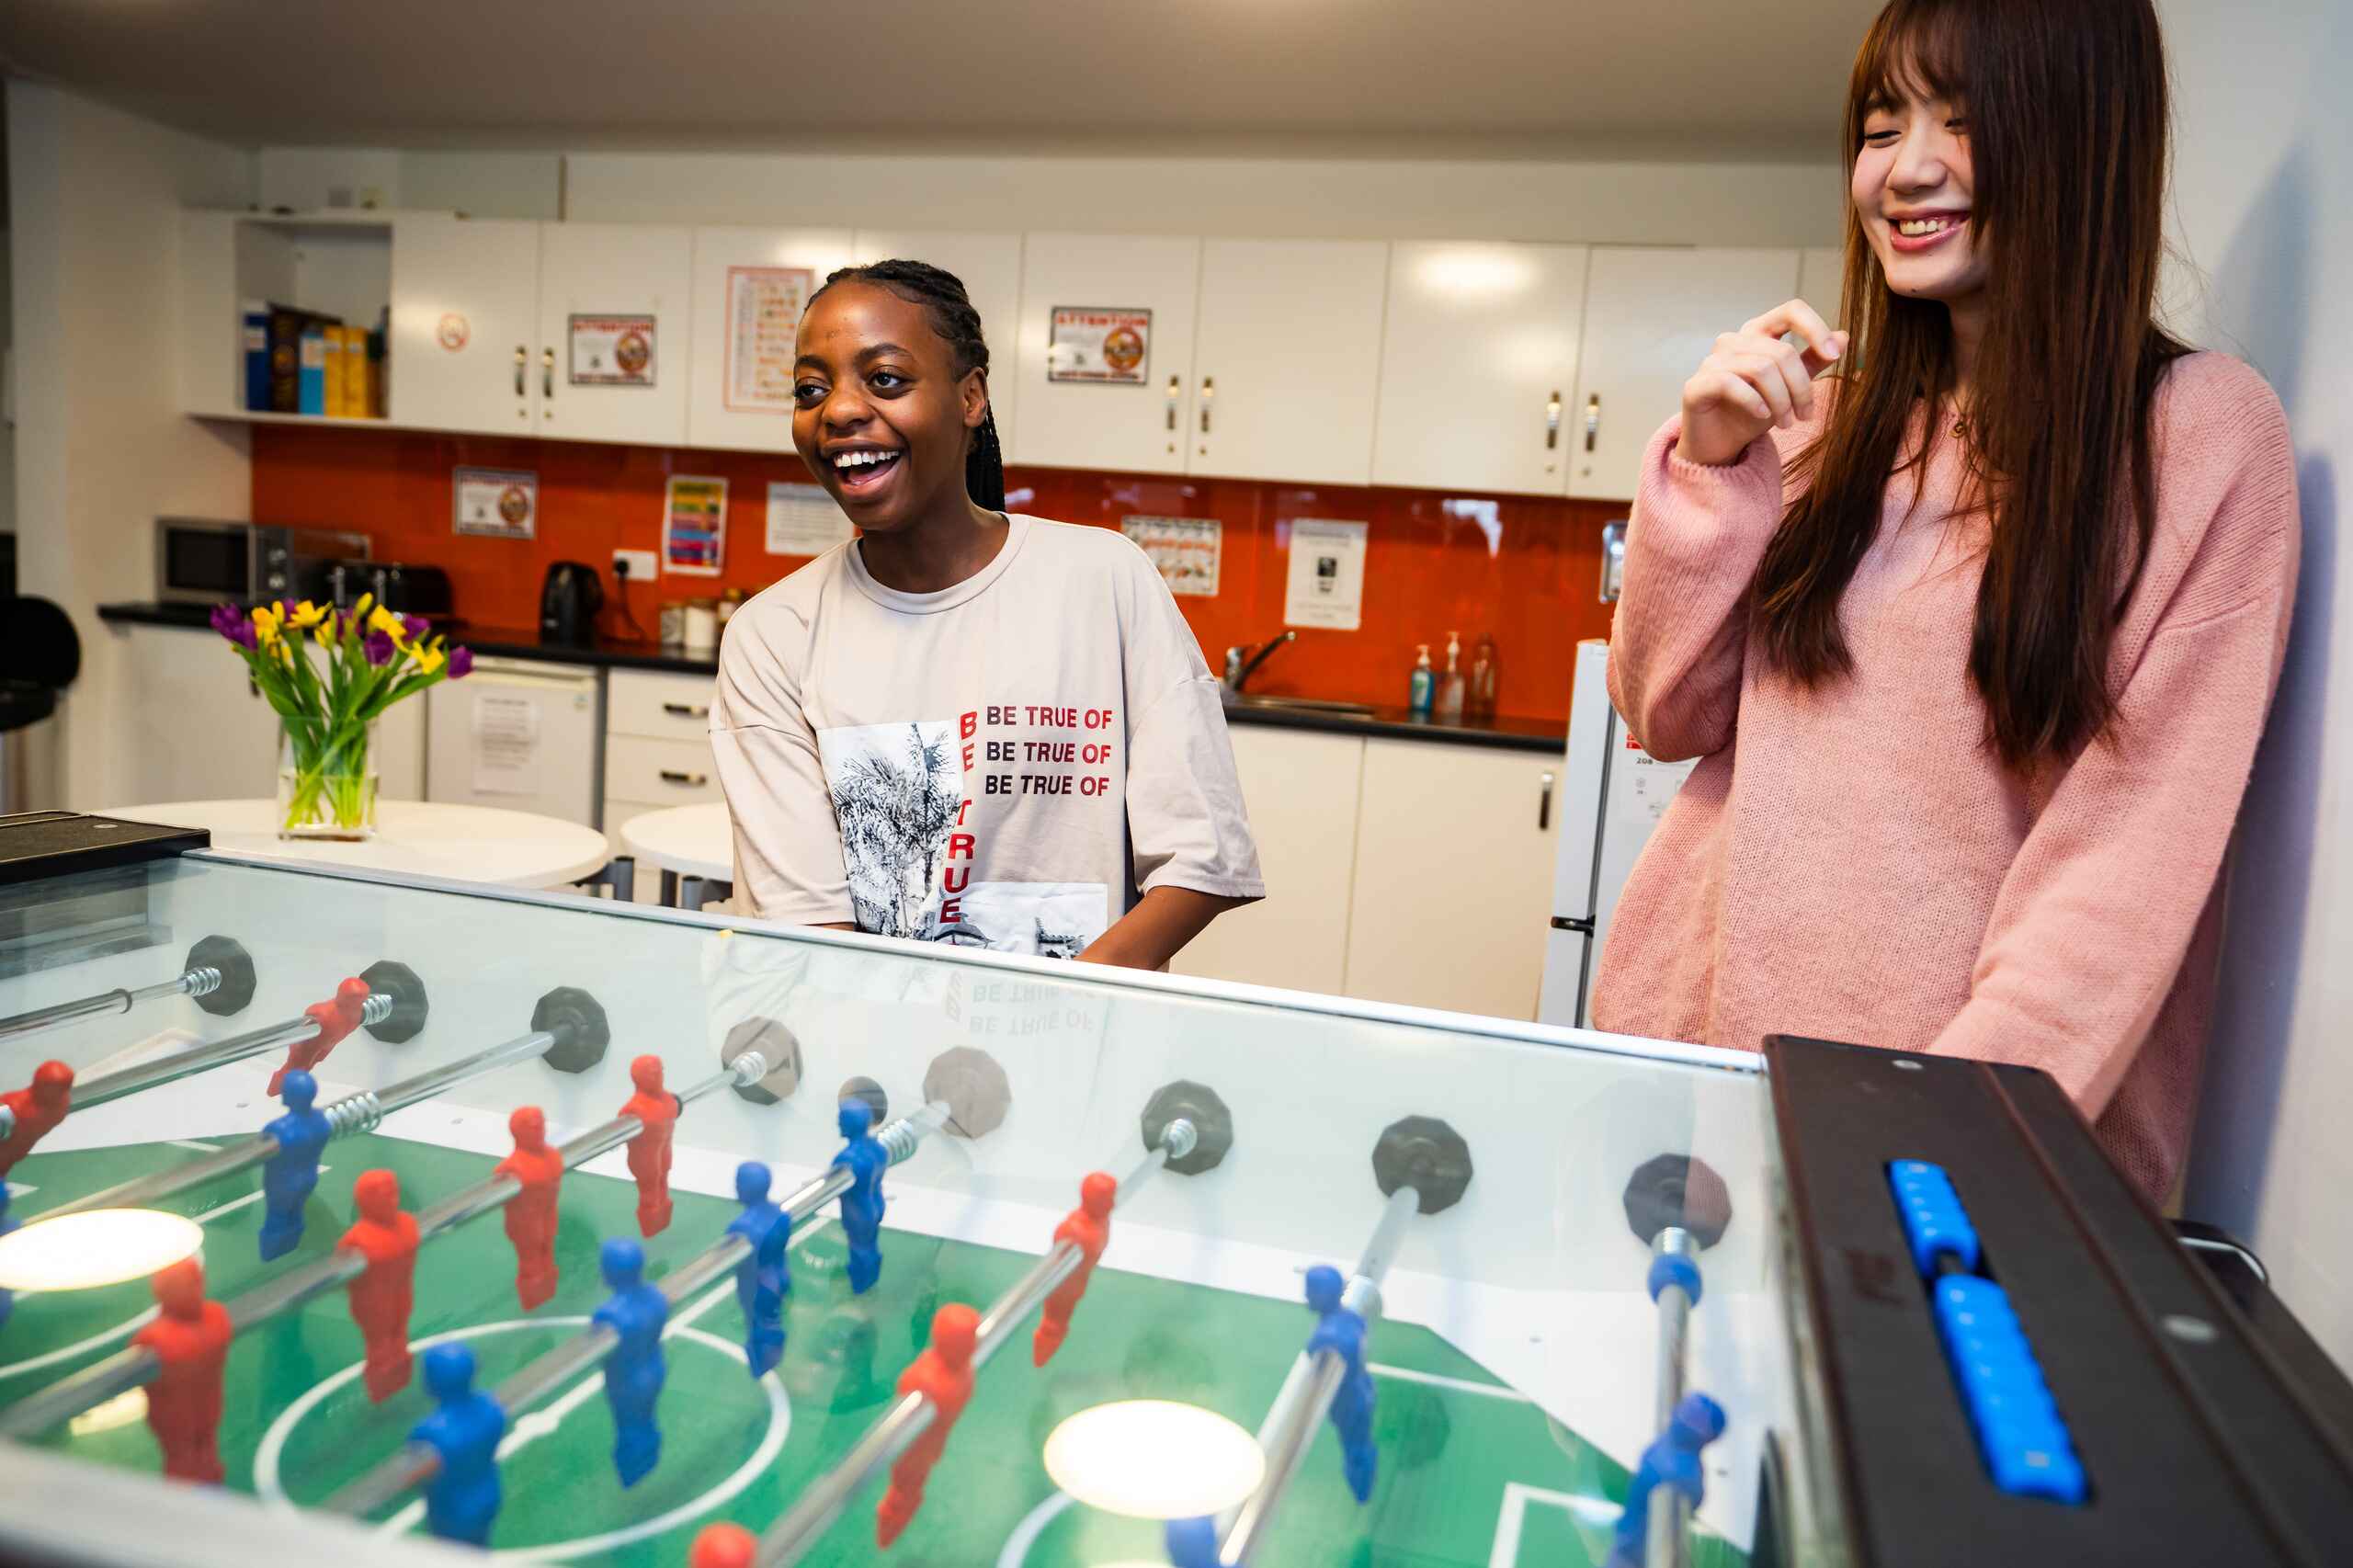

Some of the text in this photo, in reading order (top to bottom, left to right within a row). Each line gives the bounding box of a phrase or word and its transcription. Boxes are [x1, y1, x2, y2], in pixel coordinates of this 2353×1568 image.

[987, 706, 1113, 729] BE TRUE OF
[961, 711, 978, 772] BE
[986, 742, 1111, 764] BE TRUE OF
[985, 775, 1110, 796] BE TRUE OF
